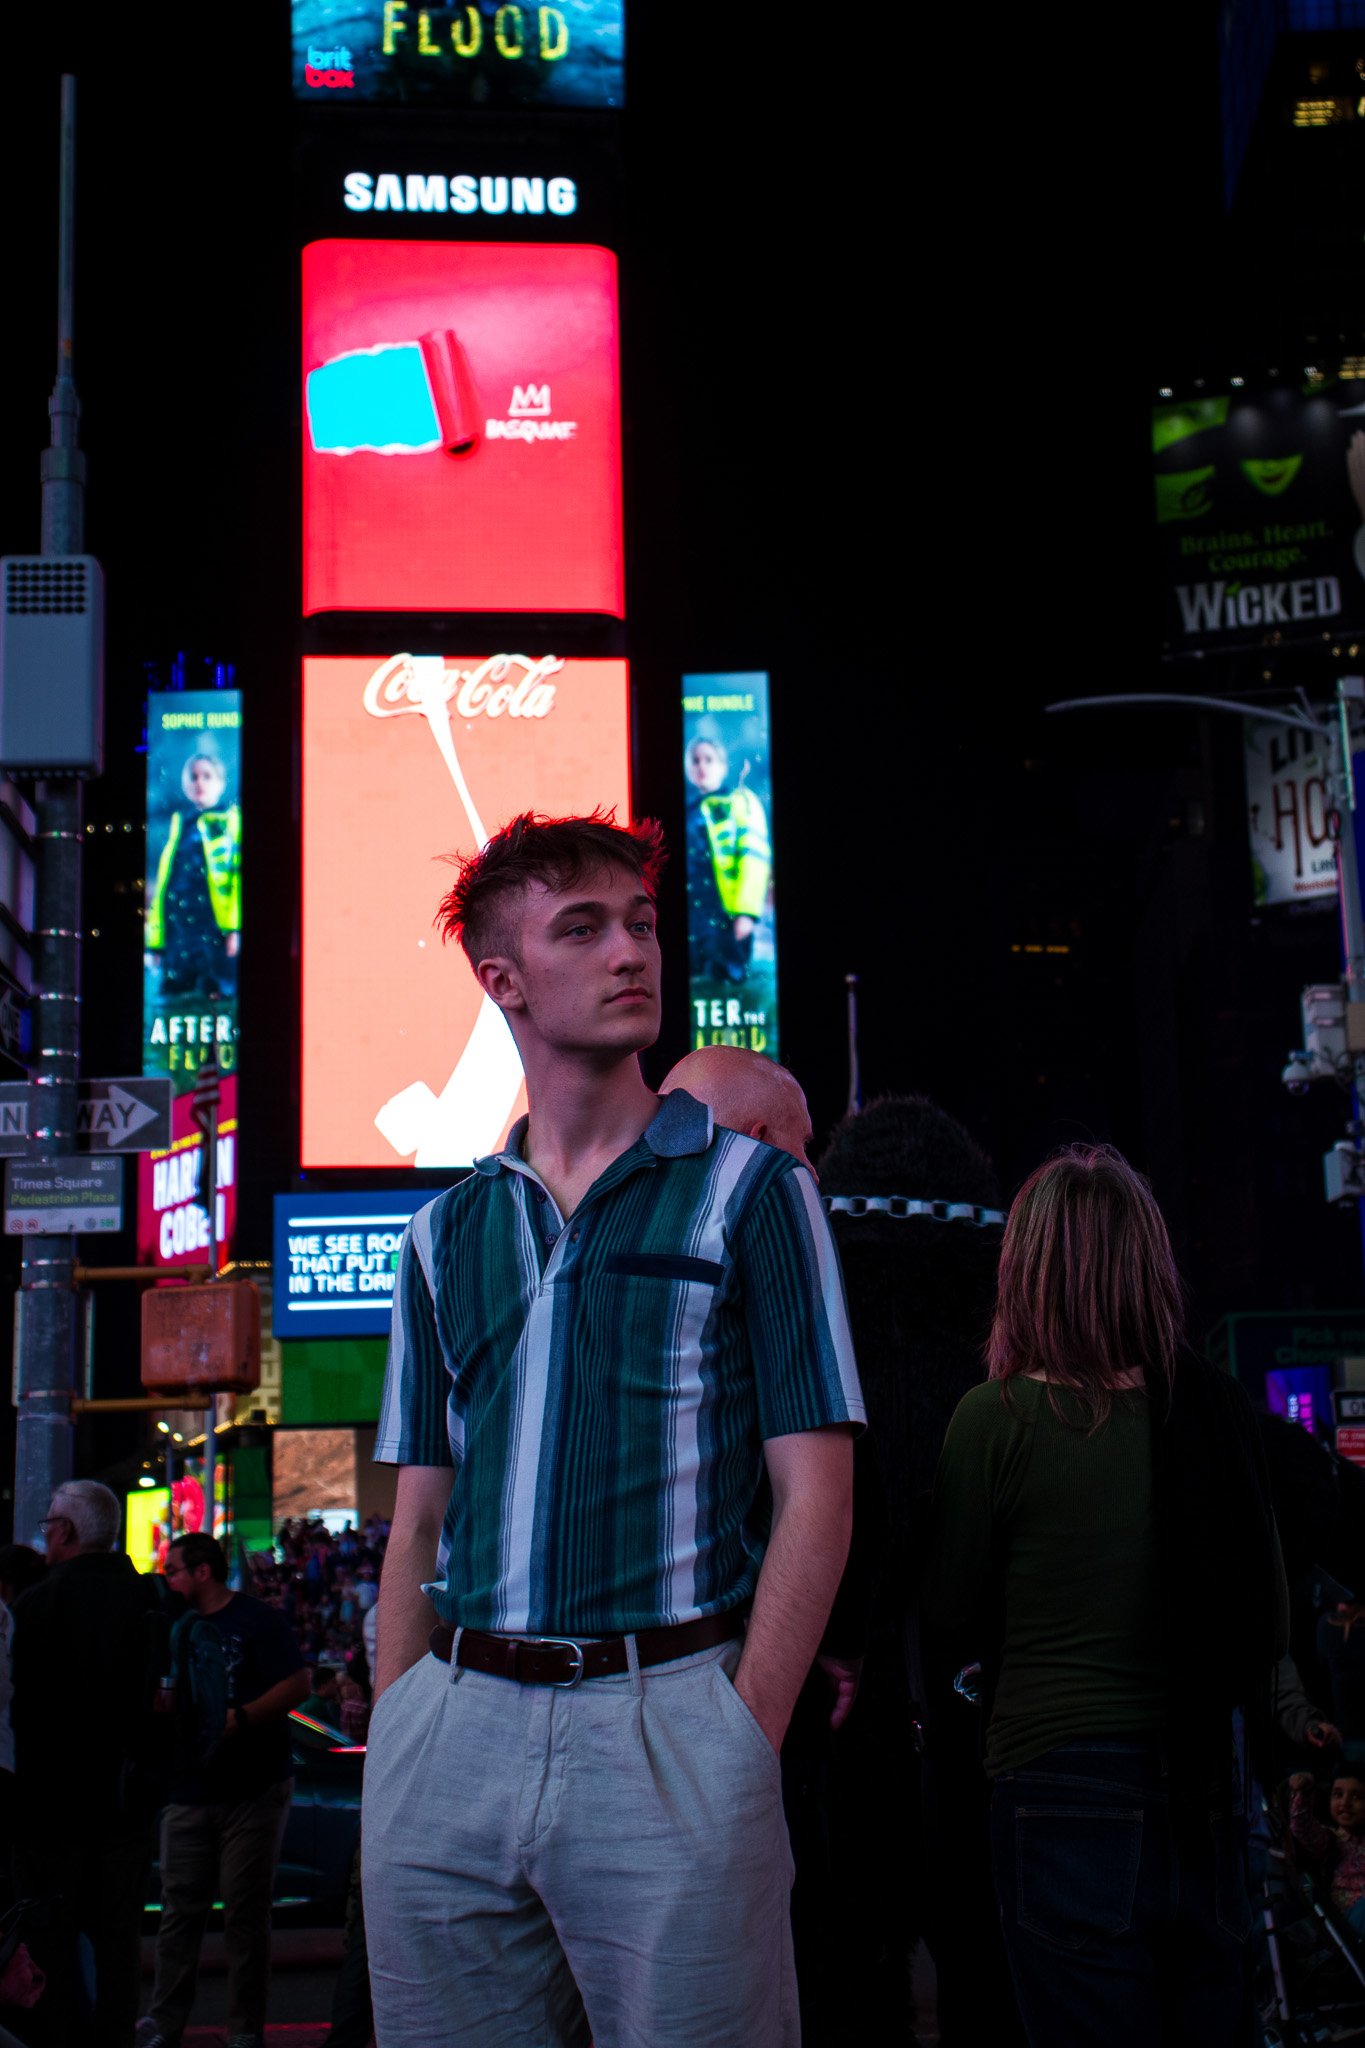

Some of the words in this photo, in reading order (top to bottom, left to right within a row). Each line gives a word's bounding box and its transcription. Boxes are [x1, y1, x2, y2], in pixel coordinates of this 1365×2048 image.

[382, 0, 569, 61] FLOOD
[308, 45, 353, 70] brit
[305, 63, 355, 89] box
[343, 172, 578, 215] SAMSUNG
[161, 711, 204, 730] SOPHIE
[150, 1014, 234, 1044] AFTER
[12, 1177, 52, 1190] Times
[54, 1175, 103, 1191] Square
[11, 1193, 79, 1206] Pedestrian
[81, 1190, 116, 1203] Plaza
[288, 1234, 322, 1255] WE
[325, 1233, 363, 1254] SEE
[288, 1253, 343, 1274] THAT
[346, 1252, 387, 1272] PUT
[288, 1274, 312, 1293] IN
[314, 1273, 355, 1293] THE
